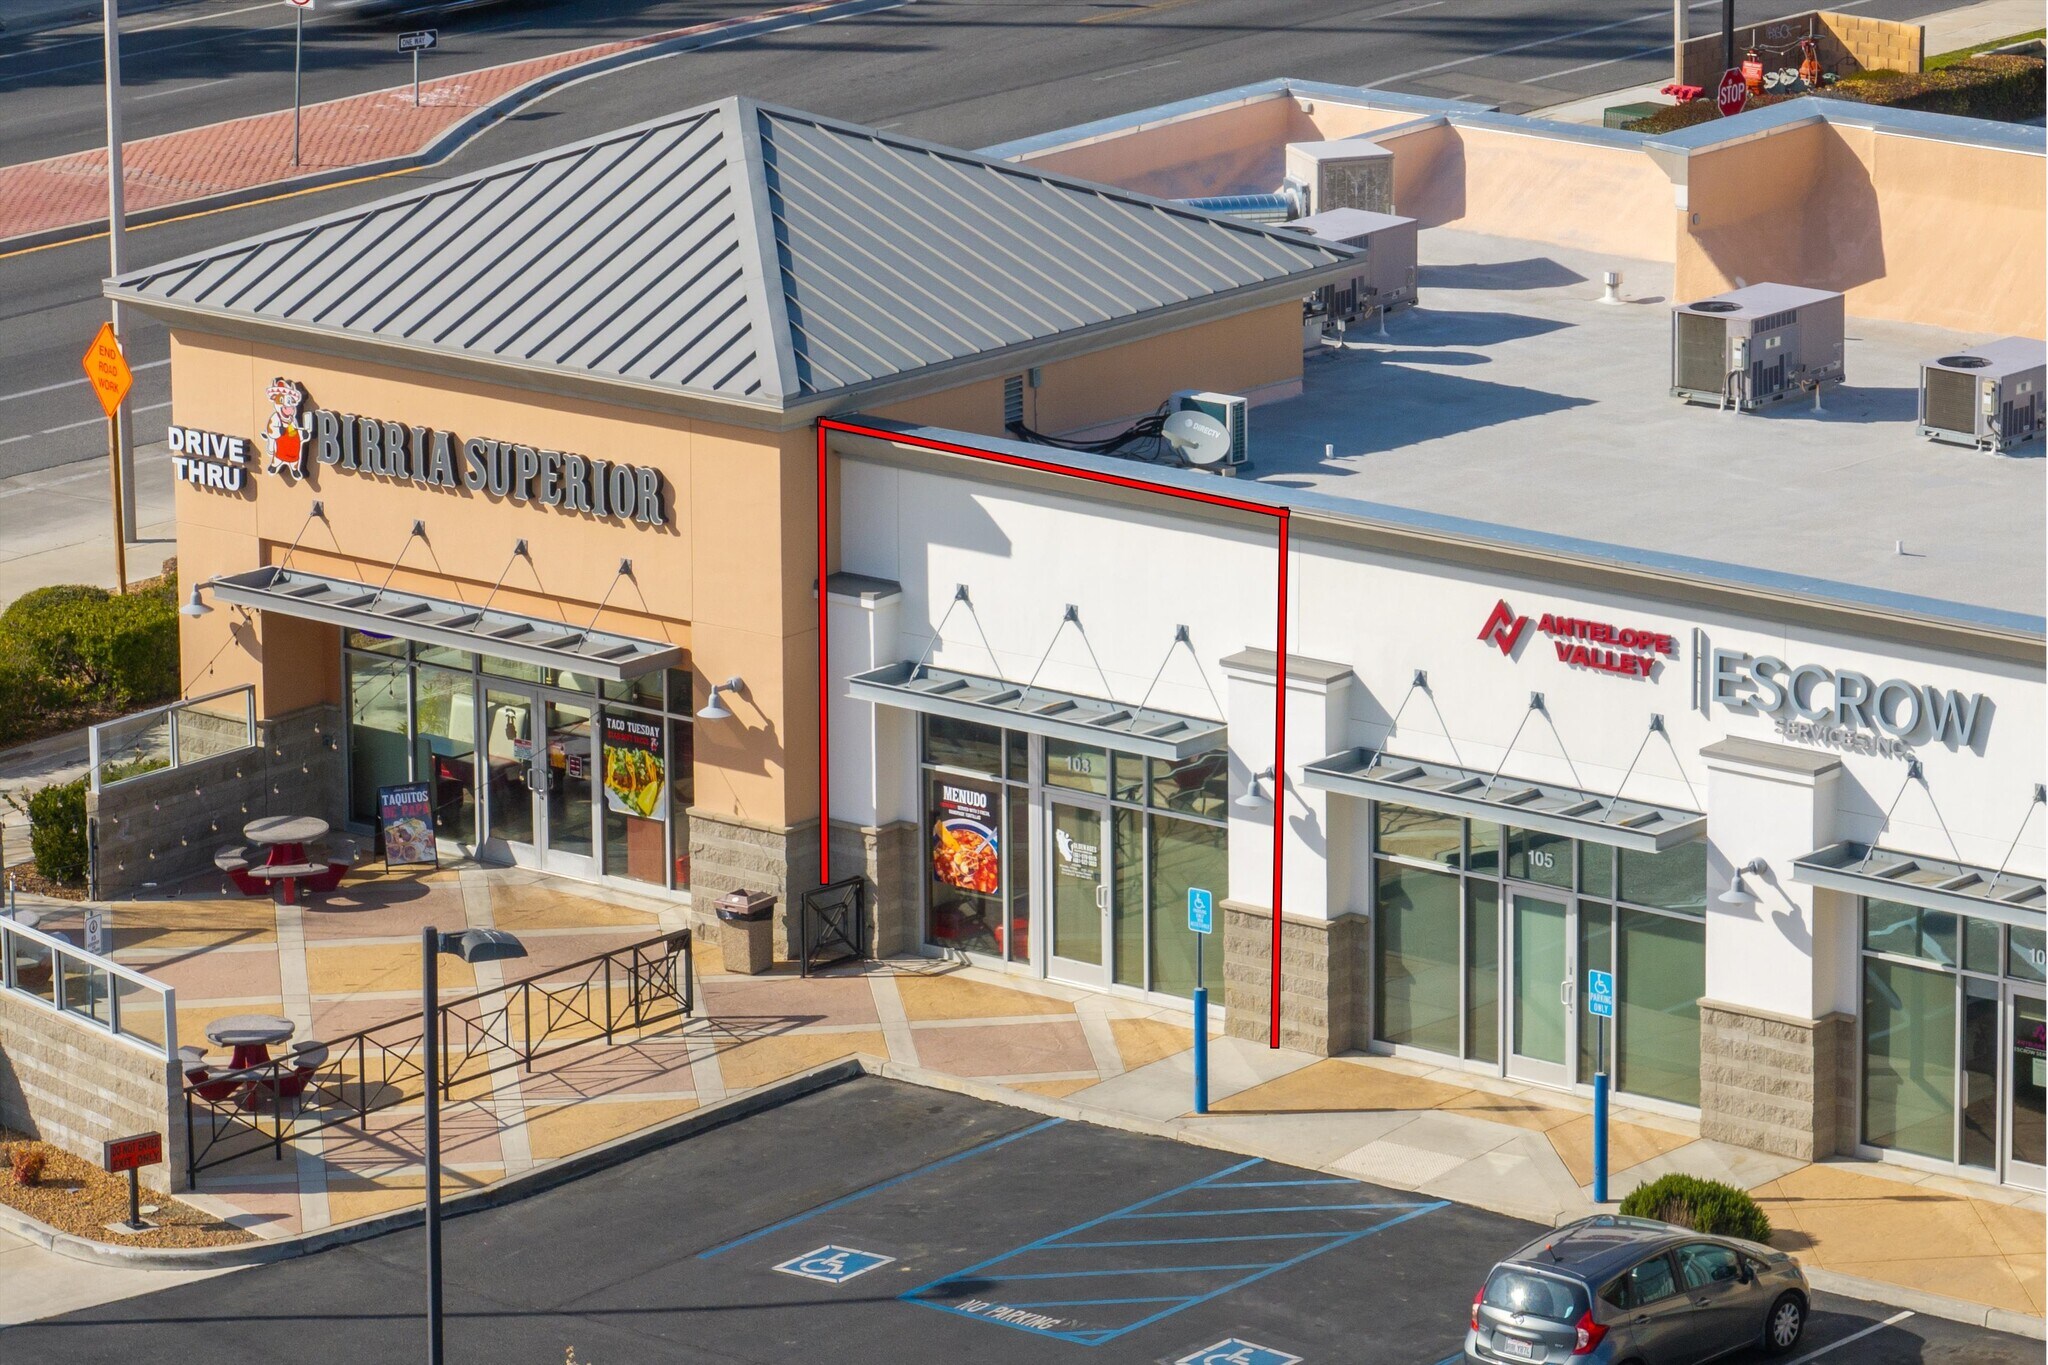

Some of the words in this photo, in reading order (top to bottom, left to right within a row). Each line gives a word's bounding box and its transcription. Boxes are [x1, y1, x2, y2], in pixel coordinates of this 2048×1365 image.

[402, 38, 413, 47] ONE
[414, 36, 425, 45] WAY
[1720, 82, 1746, 106] STOP
[99, 345, 116, 360] END
[98, 361, 118, 377] ROAD
[98, 377, 119, 393] WORK
[1193, 422, 1221, 439] DIRECTV
[168, 425, 249, 464] DRIVE
[172, 455, 245, 492] THRU
[315, 408, 459, 489] BIRRIA
[463, 437, 668, 526] SUPERIOR
[1537, 612, 1672, 655] ANTELOPE
[1554, 641, 1655, 677] VALLEY
[1712, 647, 1984, 747] ESCROW
[606, 717, 626, 732] TACO
[626, 721, 661, 738] TUESDAY
[1065, 755, 1090, 774] 103
[381, 790, 430, 807] TAQUITOS
[943, 785, 988, 809] MENUDO
[1527, 849, 1555, 868] 105
[1590, 992, 1612, 1005] PARKING
[1593, 1001, 1609, 1014] ONLY
[111, 1144, 122, 1157] DO
[123, 1140, 136, 1154] NOT
[138, 1136, 160, 1151] ENTER
[113, 1156, 132, 1170] EXIT
[138, 1150, 160, 1165] ONLY
[954, 1299, 991, 1313] NO
[983, 1305, 1063, 1330] PARKING
